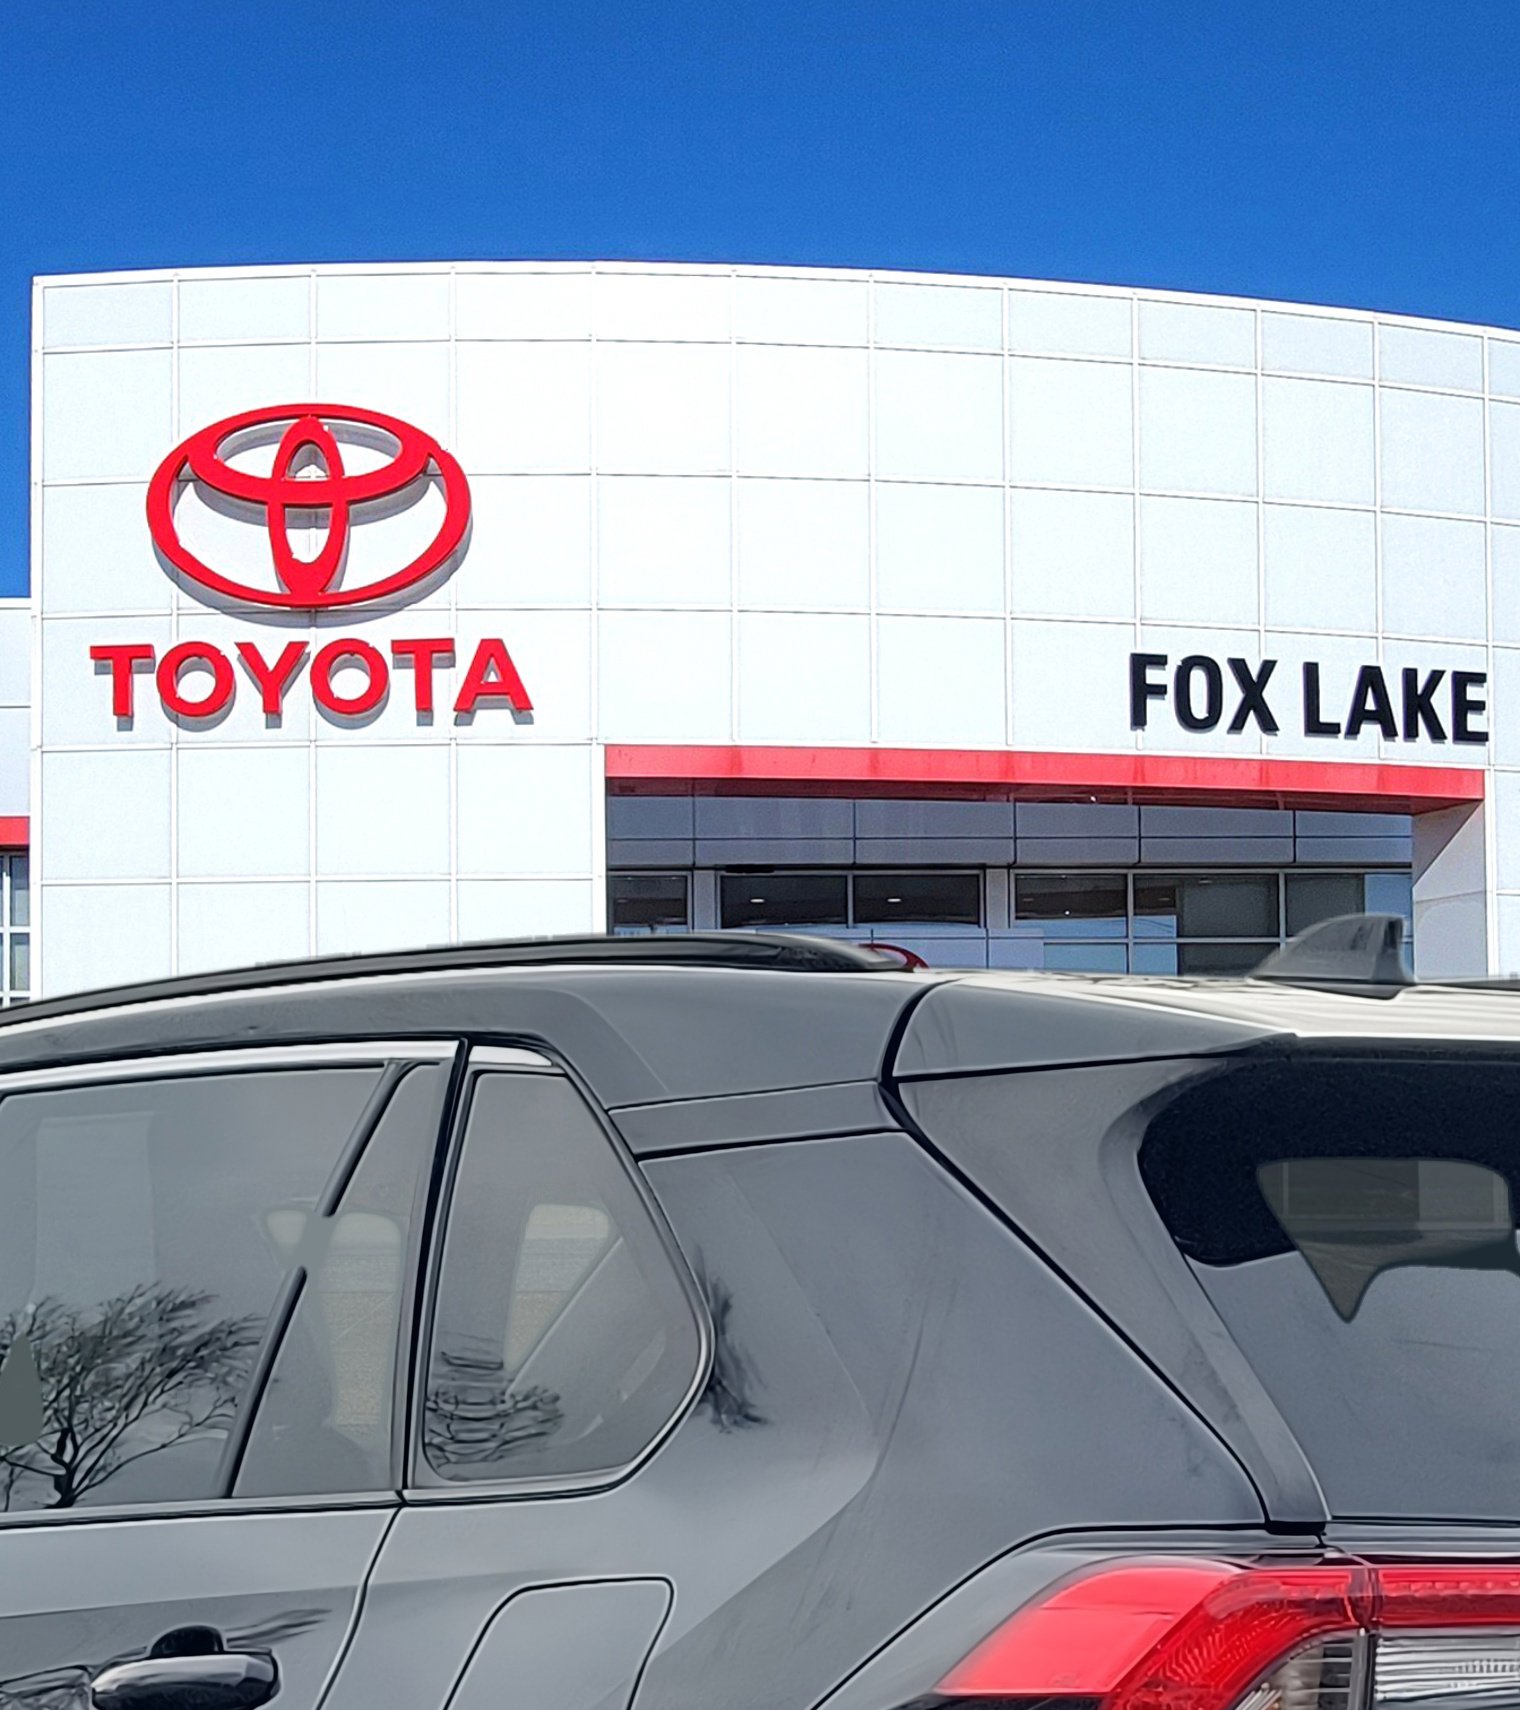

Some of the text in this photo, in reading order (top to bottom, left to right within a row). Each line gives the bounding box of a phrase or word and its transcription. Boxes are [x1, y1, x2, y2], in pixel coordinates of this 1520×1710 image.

[89, 637, 535, 722] TOYOTA
[1129, 652, 1490, 744] FOX LAKE
